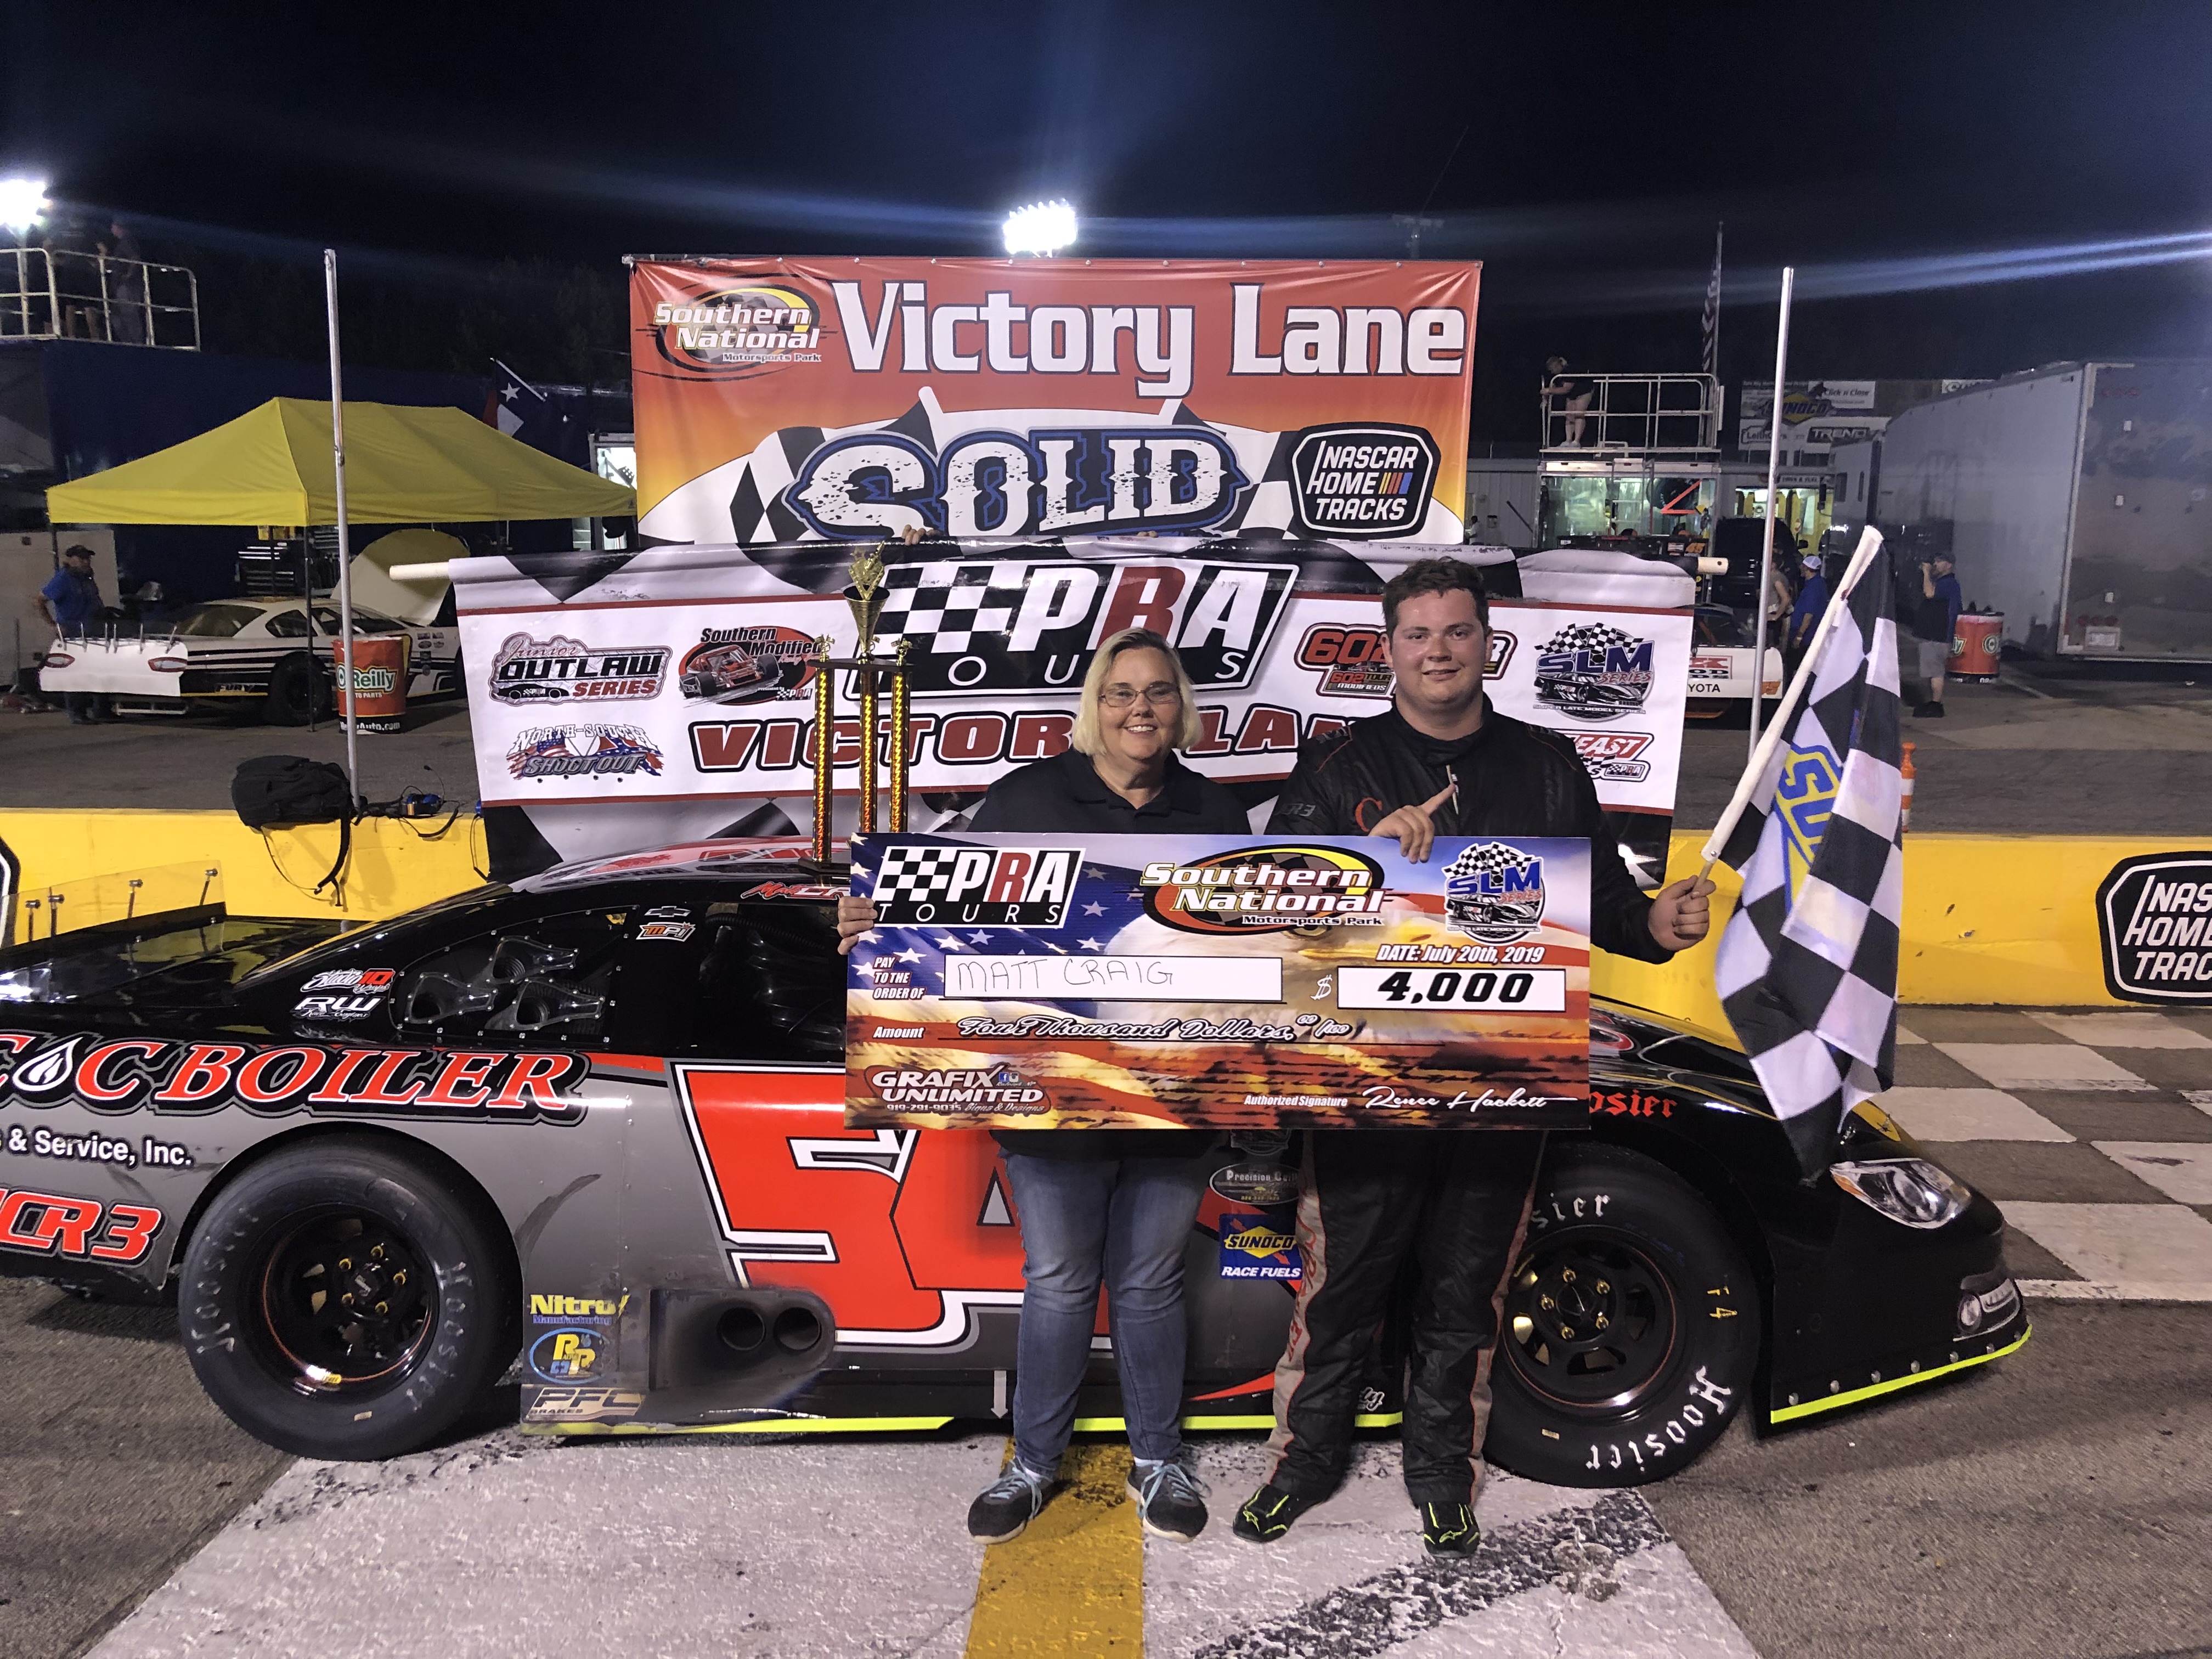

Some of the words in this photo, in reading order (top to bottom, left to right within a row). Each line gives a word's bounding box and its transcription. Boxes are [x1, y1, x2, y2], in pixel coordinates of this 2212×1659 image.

[655, 301, 811, 325] Southern
[675, 326, 820, 349] National
[832, 280, 1195, 399] Victory
[1228, 282, 1467, 376] Lane
[723, 353, 792, 363] Motorsports
[794, 353, 822, 363] Park
[1321, 445, 1419, 470] NASCAR
[797, 438, 1227, 538] SOLID
[1306, 460, 1378, 495] HOME
[1314, 498, 1408, 521] TRACKS
[1006, 565, 1271, 653] PRA
[701, 627, 778, 643] Southern
[501, 639, 580, 667] Junior
[1537, 640, 1655, 674] SLM
[498, 653, 663, 680] OUTLAW
[1330, 672, 1366, 684] 602
[1595, 669, 1653, 684] SERIES
[572, 679, 657, 697] SERIES
[1688, 683, 1721, 693] YOTA
[689, 712, 1074, 772] VICTOR
[945, 851, 1070, 902] PRA
[1139, 862, 1371, 888] Southern
[1447, 859, 1542, 895] SLM
[1169, 888, 1385, 913] National
[1500, 888, 1542, 904] SERIES
[2145, 881, 2212, 913] NAS
[878, 902, 1062, 923] TOURS
[1242, 915, 1341, 927] Motorsports
[1346, 916, 1384, 927] Park
[873, 957, 896, 968] PAY
[1375, 945, 1421, 963] DATE:
[1421, 945, 1458, 964] July
[1459, 946, 1498, 964] 20th,
[1500, 946, 1545, 963] 2019
[2134, 951, 2212, 980] TRAC
[357, 970, 394, 985] 10
[874, 972, 889, 984] TO
[889, 972, 910, 984] THE
[957, 958, 1048, 992] MATT
[1063, 958, 1173, 986] CRAIG
[873, 988, 910, 999] ORDER
[910, 988, 925, 999] OF
[1310, 974, 1333, 1001] $
[1377, 971, 1534, 1004] 4,000
[873, 1026, 925, 1039] Amount
[958, 1016, 1031, 1037] Four
[1024, 1015, 1176, 1039] Thousand
[75, 1041, 168, 1102] C
[154, 1042, 574, 1110] BOILER
[872, 1065, 1005, 1088] GRAFIX
[881, 1088, 1044, 1103] UNLIMITED
[1244, 1094, 1298, 1107] Authorized
[1299, 1094, 1347, 1108] Signature
[1589, 1088, 1678, 1118] osier
[8, 1128, 28, 1151] &
[36, 1128, 137, 1166] Service,
[145, 1139, 191, 1166] Inc.
[1226, 1169, 1271, 1181] Precision
[0, 1187, 162, 1261] CR3
[1227, 1235, 1295, 1249] SUNOCO
[1221, 1266, 1259, 1277] RACE
[1260, 1267, 1302, 1278] FUELS
